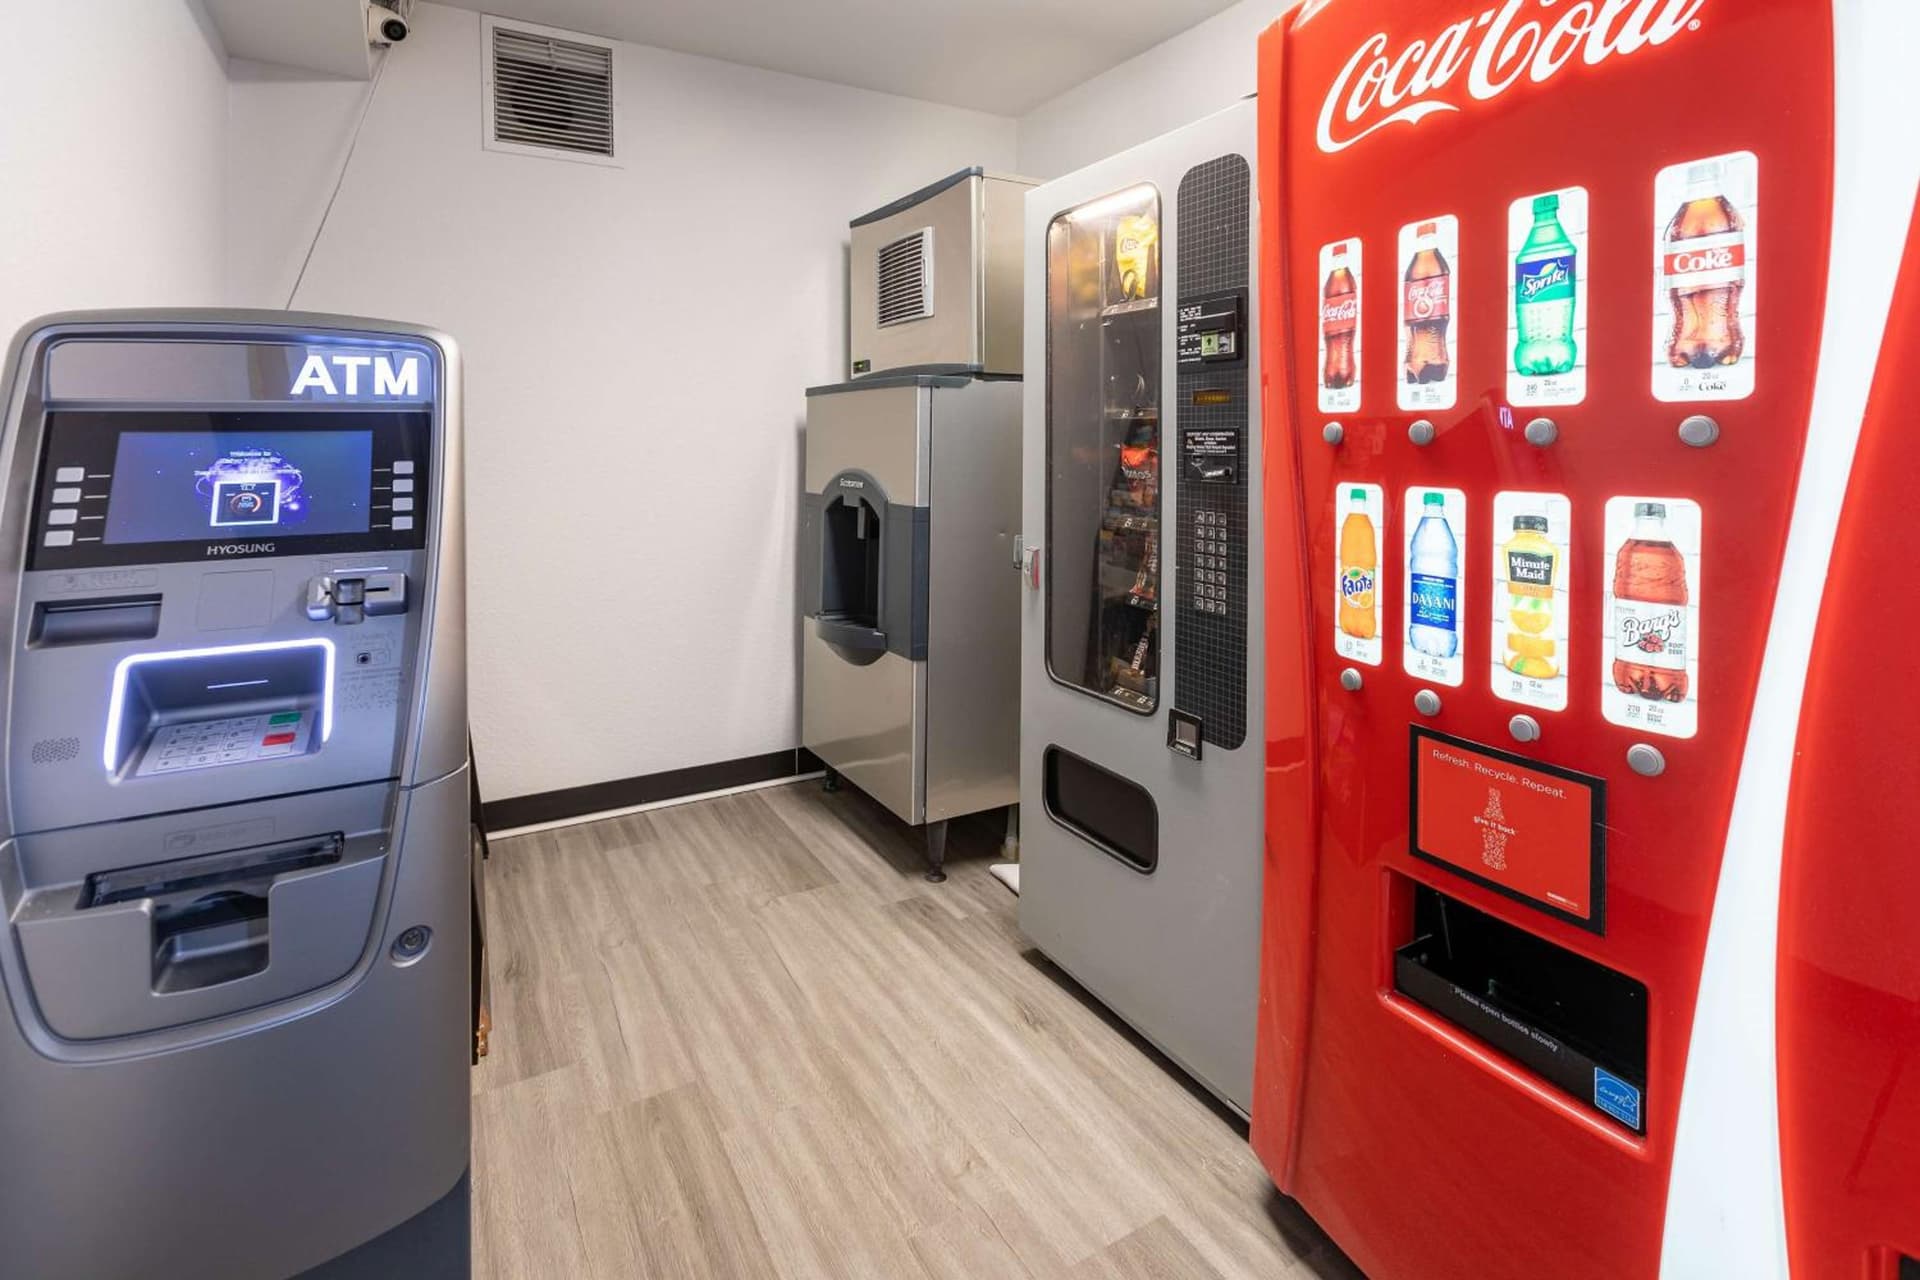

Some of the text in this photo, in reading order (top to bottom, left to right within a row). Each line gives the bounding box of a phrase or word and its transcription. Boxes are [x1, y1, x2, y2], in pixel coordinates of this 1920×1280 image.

[1673, 248, 1733, 273] Coke
[1525, 266, 1567, 296] Sprite
[290, 355, 418, 396] ATM
[206, 543, 276, 556] HYOSUNG
[1511, 556, 1550, 570] Minute
[1516, 567, 1545, 580] Maid
[1622, 609, 1681, 648] Barq's
[1433, 749, 1567, 799] Refresh. Recycle. Repeat.
[1473, 815, 1489, 827] give
[1497, 821, 1516, 835] back
[1454, 986, 1558, 1052] Please open bottles slowly
